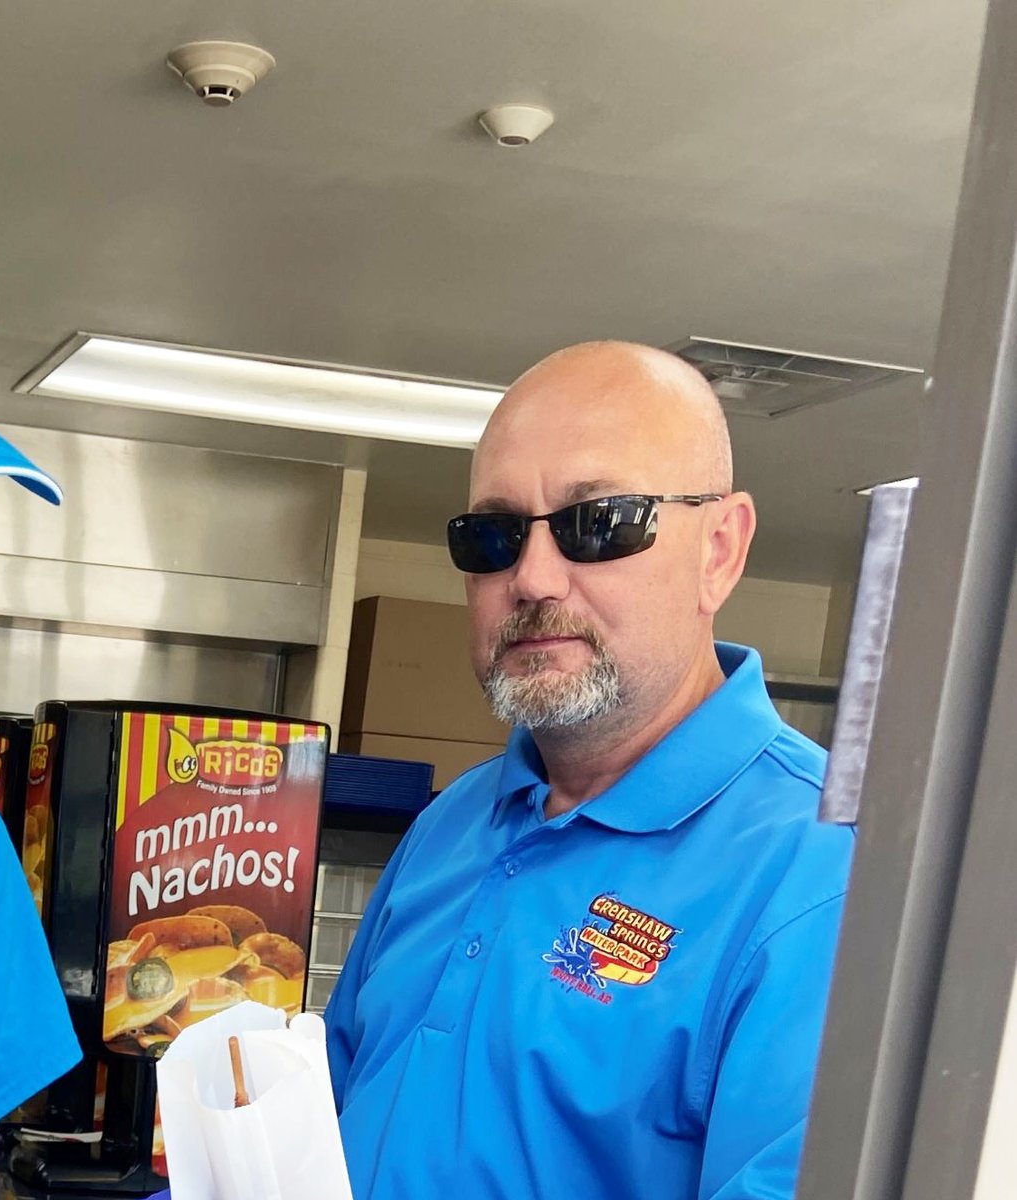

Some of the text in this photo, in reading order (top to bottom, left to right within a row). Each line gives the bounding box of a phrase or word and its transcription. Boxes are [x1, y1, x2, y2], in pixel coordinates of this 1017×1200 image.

[196, 779, 218, 794] Family
[218, 786, 241, 796] Owned
[242, 787, 260, 796] Since
[135, 803, 278, 862] mmm...
[128, 844, 300, 916] Nachos!
[583, 928, 647, 967] WATER PARK
